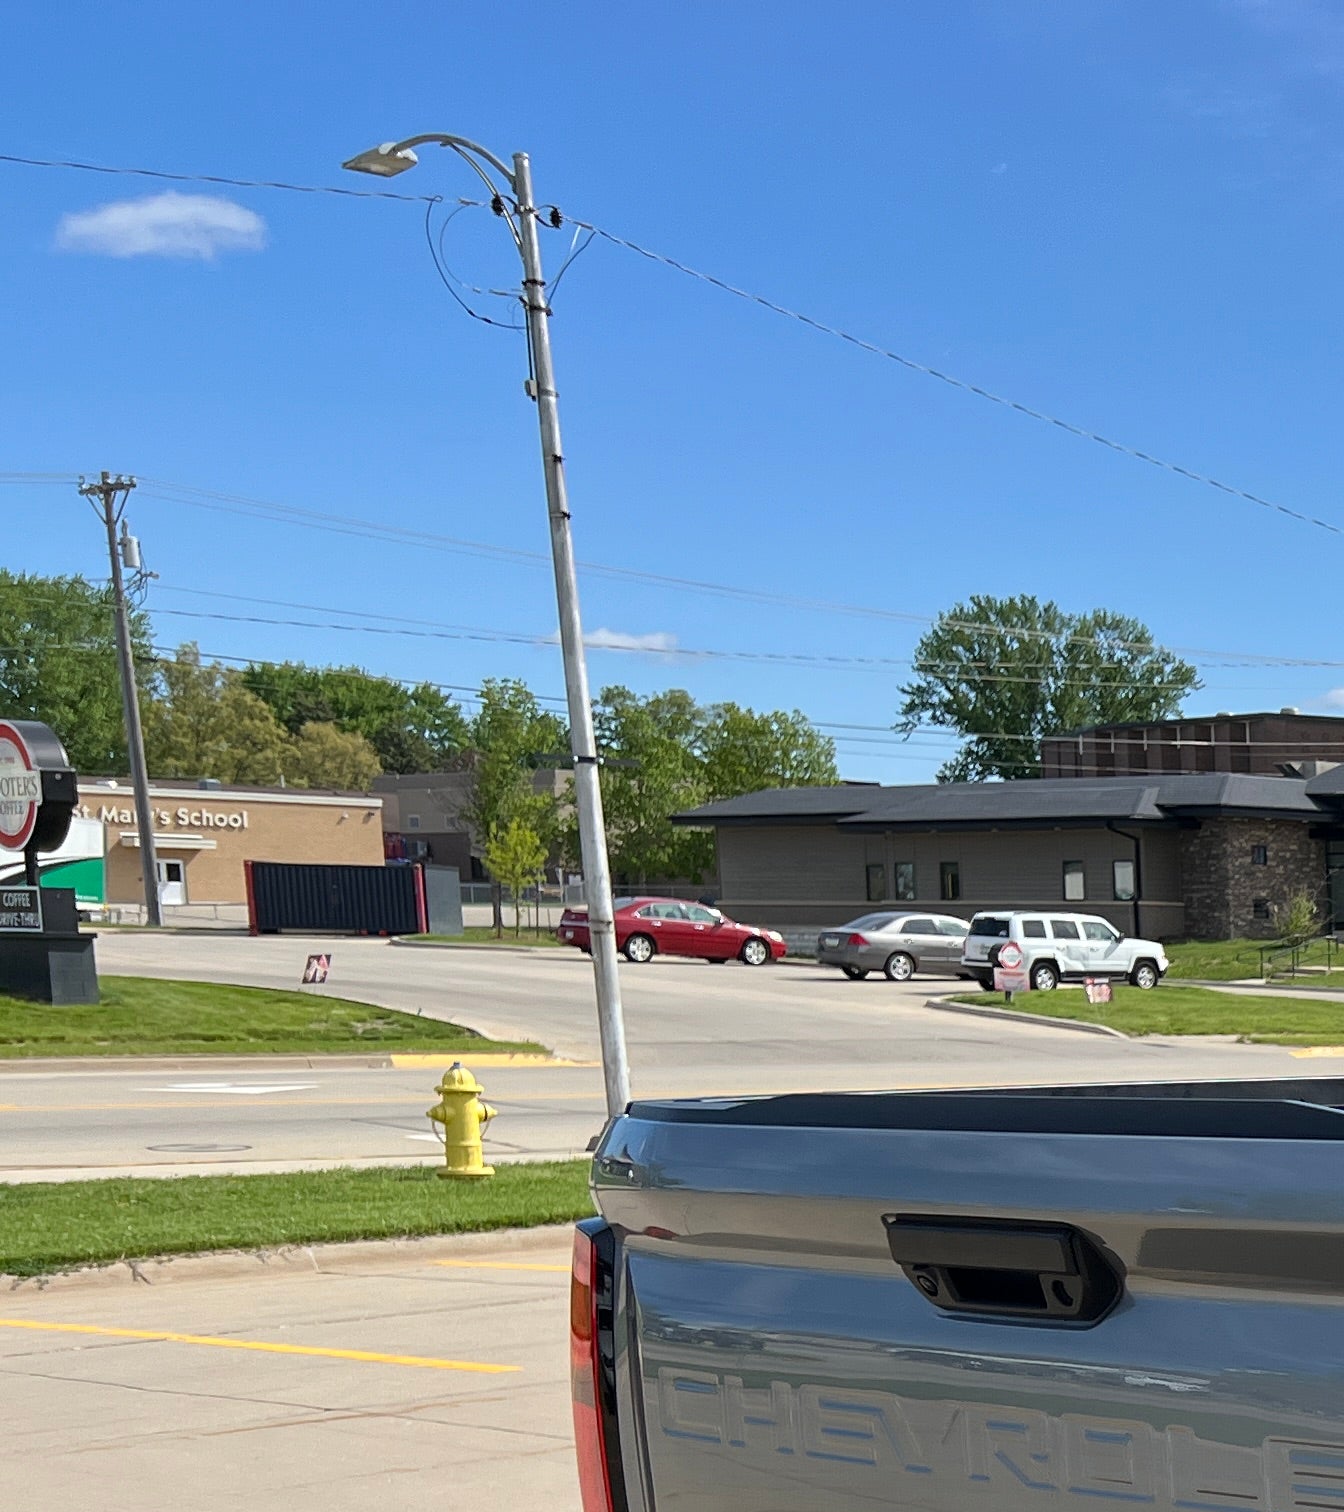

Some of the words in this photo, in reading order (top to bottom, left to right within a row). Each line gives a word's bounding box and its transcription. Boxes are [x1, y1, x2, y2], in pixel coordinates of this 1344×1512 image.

[0, 776, 38, 797] OTER'S
[100, 805, 171, 825] Mar's
[177, 807, 248, 829] School
[2, 892, 31, 907] COFFEE
